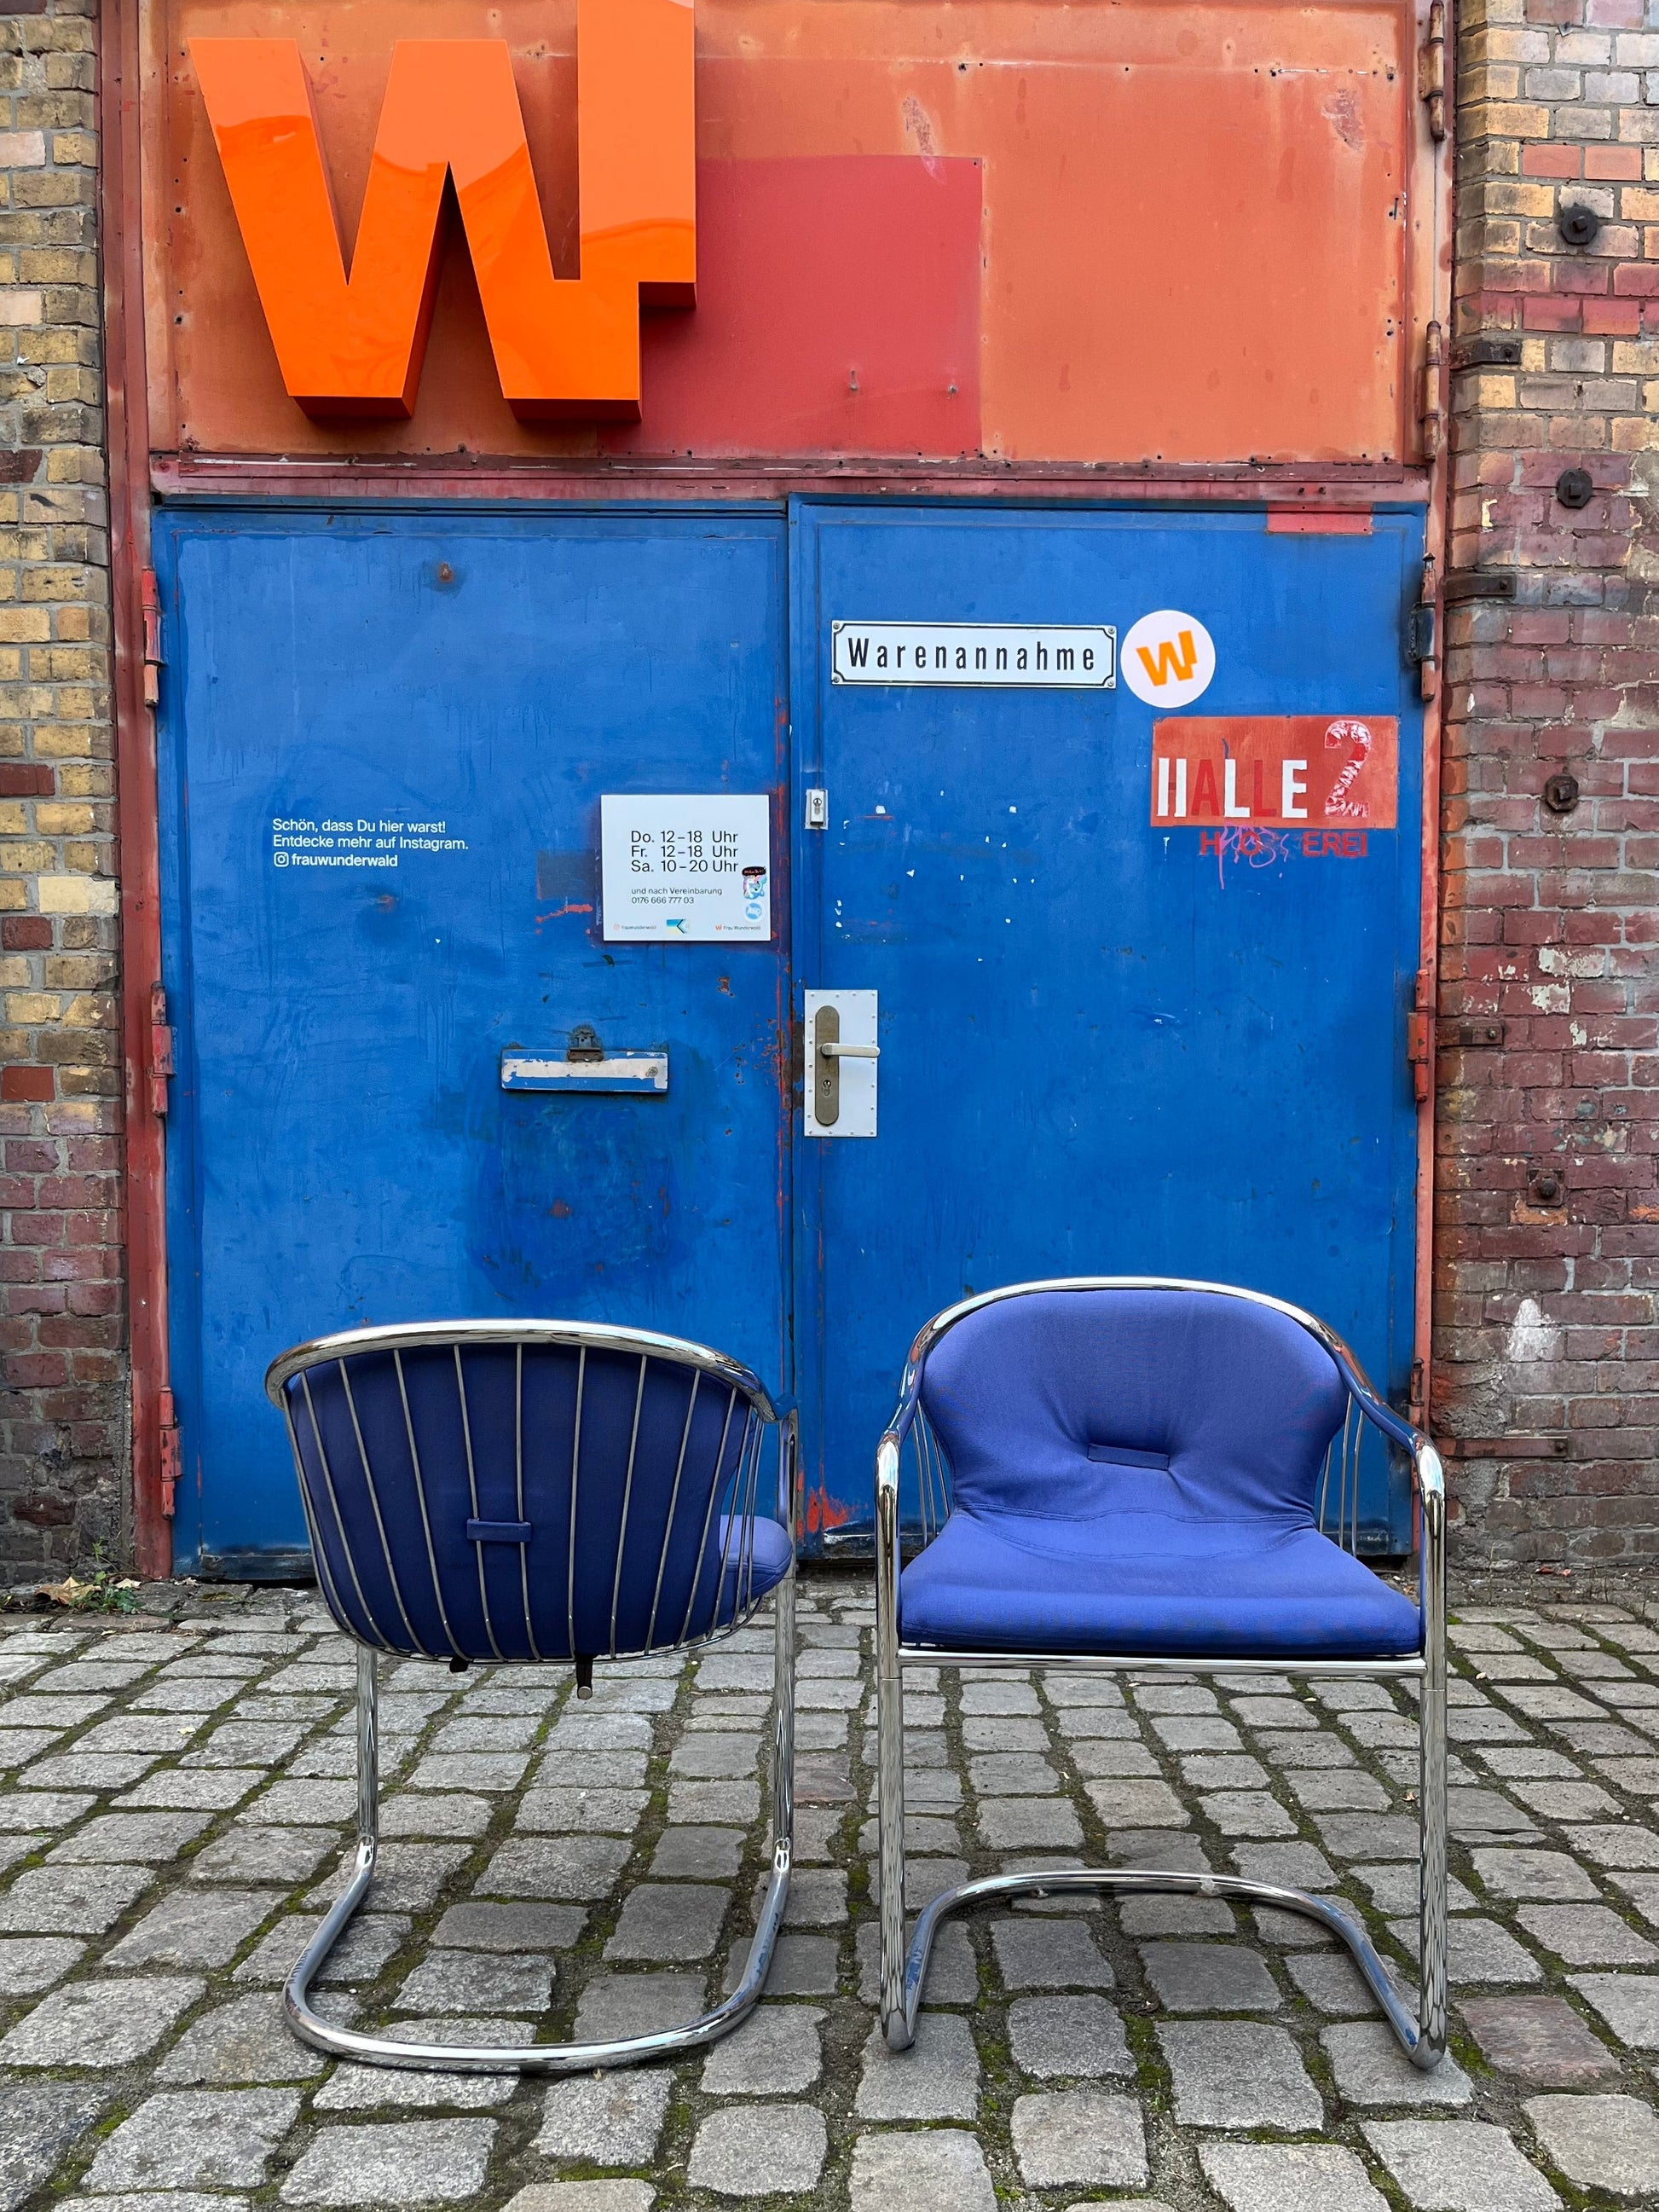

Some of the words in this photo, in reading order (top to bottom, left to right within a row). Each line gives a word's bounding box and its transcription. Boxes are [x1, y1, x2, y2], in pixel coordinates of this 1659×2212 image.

[848, 638, 1093, 670] Warenannahme
[1156, 757, 1308, 819] HALLE
[1324, 720, 1372, 819] 2
[273, 819, 318, 832] Schön,
[322, 819, 353, 831] dass
[358, 819, 375, 831] Du
[380, 820, 404, 831] hier
[408, 821, 445, 832] warst!
[274, 835, 333, 847] Entdecke
[338, 837, 372, 848] mehr
[376, 837, 396, 848] auf
[401, 837, 468, 851] Instagram.
[631, 831, 655, 843] Do.
[712, 831, 738, 843] Uhr
[631, 845, 648, 857] Fr.
[712, 846, 739, 857] Uhr
[292, 854, 397, 866] frauwunderwald
[631, 860, 654, 871] Sa.
[712, 860, 739, 871] Uhr
[670, 888, 722, 896] Vereinbarung
